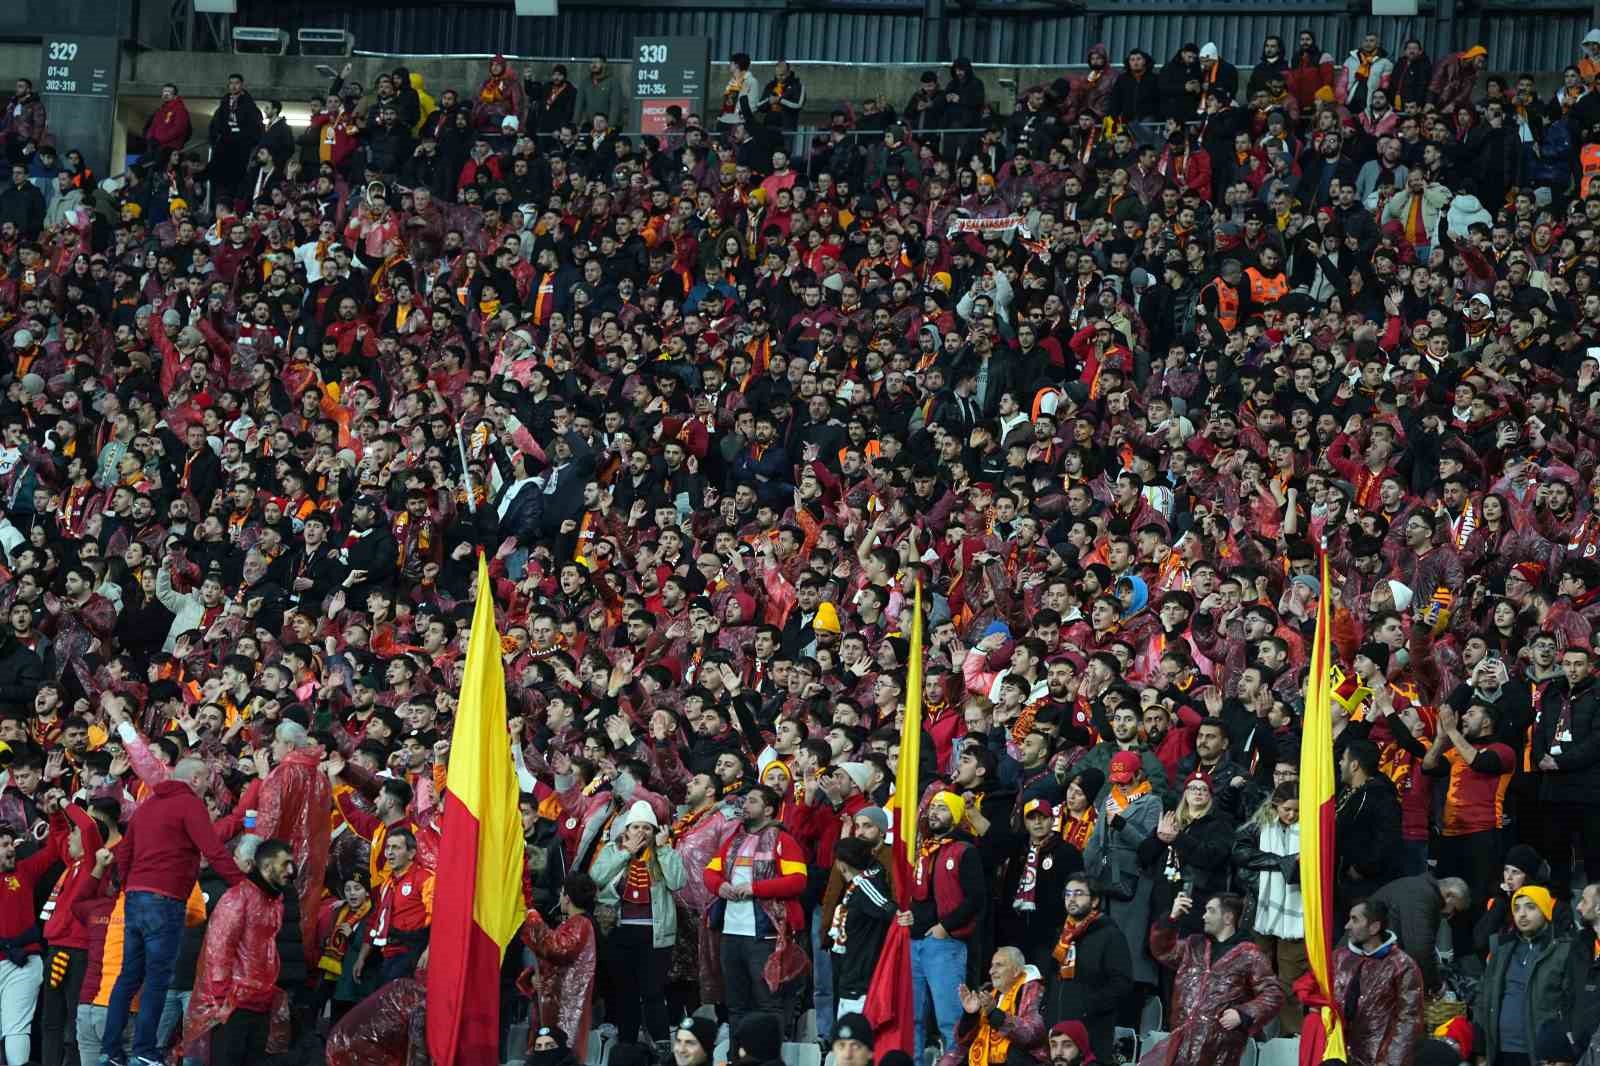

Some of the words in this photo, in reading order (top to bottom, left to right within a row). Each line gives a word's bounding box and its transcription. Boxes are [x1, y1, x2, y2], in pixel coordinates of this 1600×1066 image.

[49, 42, 78, 61] 329
[639, 44, 667, 63] 330
[638, 69, 659, 81] 01-48
[637, 84, 666, 95] 321-354
